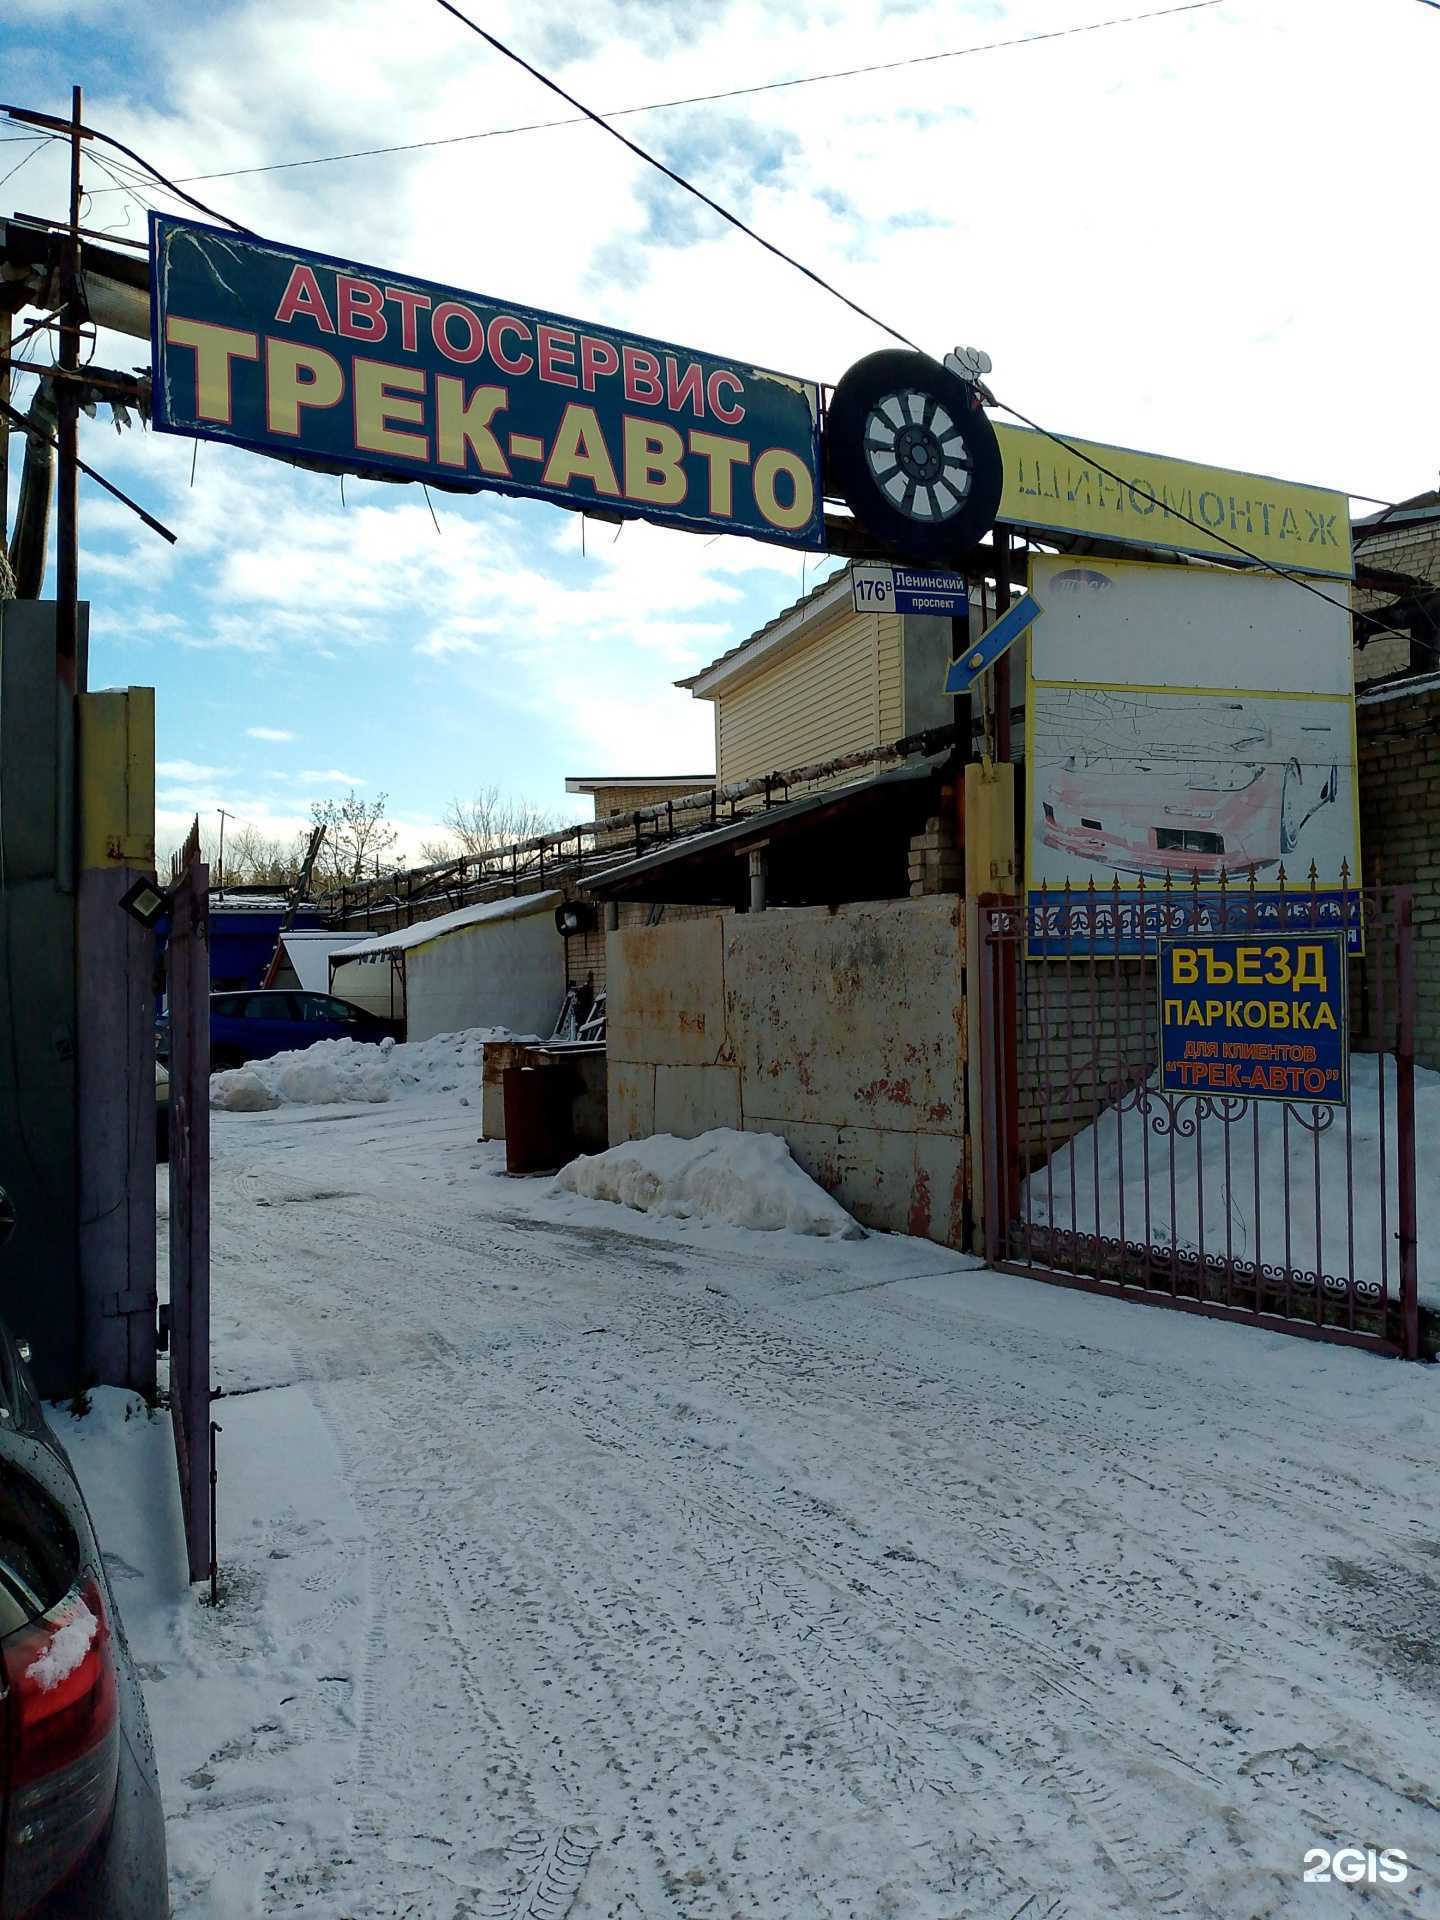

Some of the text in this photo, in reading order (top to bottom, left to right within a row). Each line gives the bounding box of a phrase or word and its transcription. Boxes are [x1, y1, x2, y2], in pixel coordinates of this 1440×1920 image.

[275, 265, 746, 424] АВТОСЕРВИС
[167, 316, 814, 530] ТРЕК-АВТО
[1018, 457, 1340, 547] ШИНОМОНТАЖ
[896, 572, 964, 590] Ленинский
[912, 597, 955, 610] проспект
[1172, 945, 1327, 992] ВЪЕЗД
[1164, 999, 1338, 1030] ПАРКОВКА
[1184, 1041, 1317, 1063] ДЛЯ КЛИЕНТОВ
[1165, 1060, 1339, 1093] “ТРЕК-АВТО”
